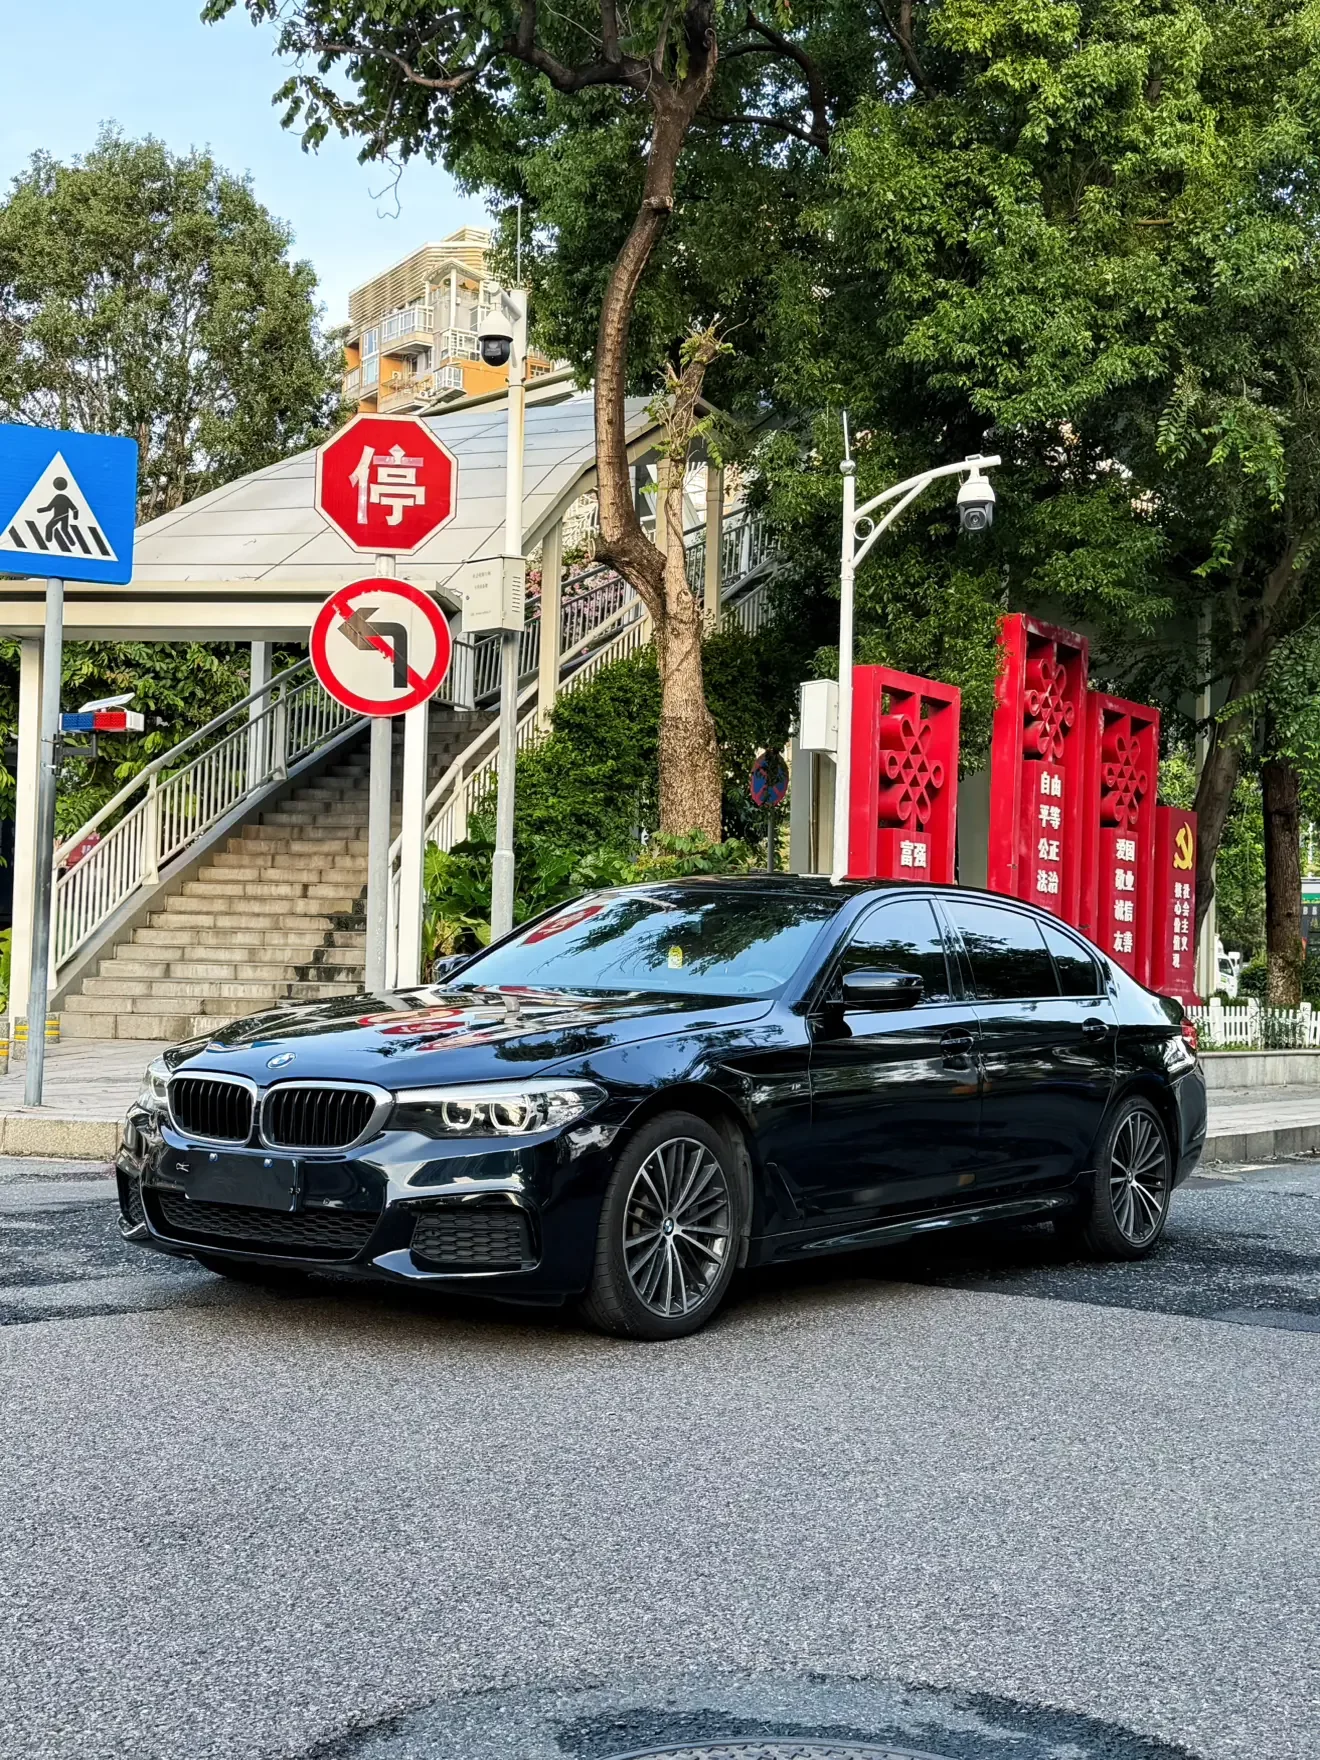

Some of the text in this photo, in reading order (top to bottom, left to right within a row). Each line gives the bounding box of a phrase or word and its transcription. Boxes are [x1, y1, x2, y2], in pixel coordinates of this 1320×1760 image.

[349, 444, 425, 526] 停
[1041, 771, 1061, 797] 自由
[1039, 804, 1060, 829] 平等
[900, 840, 926, 867] 富强
[1038, 838, 1059, 861] 公正
[1116, 839, 1135, 862] 爱国
[1037, 869, 1058, 894] 法治
[1115, 868, 1134, 891] 敬业
[1114, 900, 1133, 922] 诚信
[1113, 931, 1132, 953] 友善
